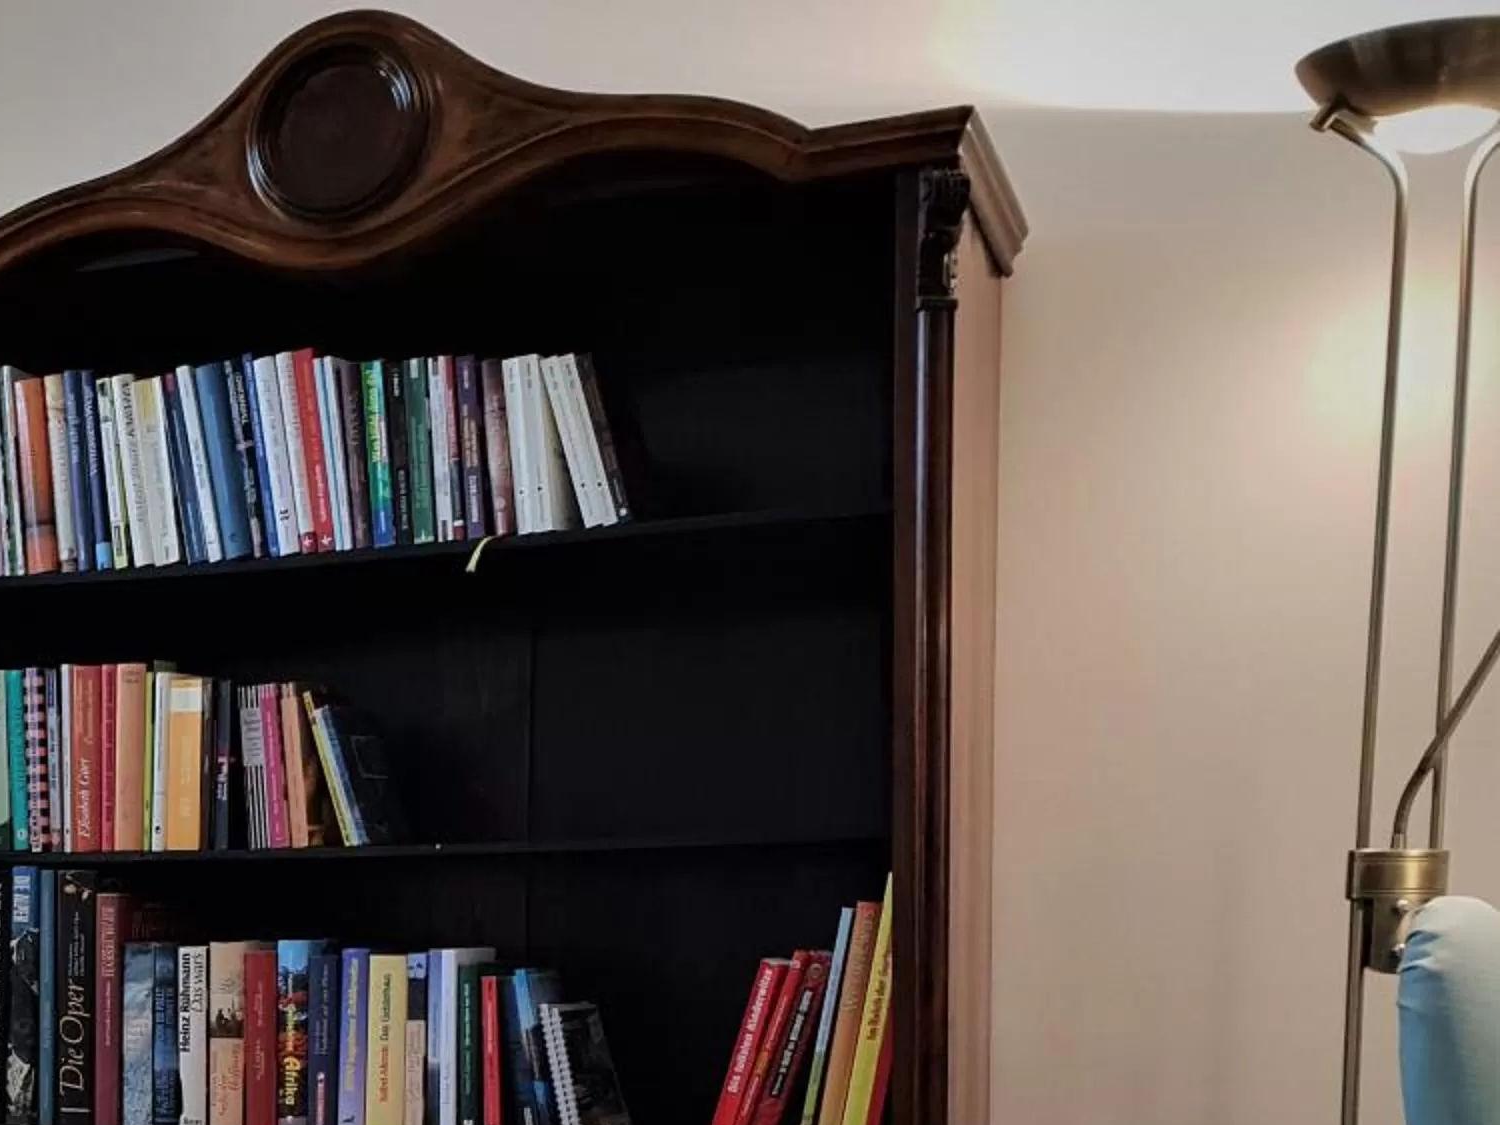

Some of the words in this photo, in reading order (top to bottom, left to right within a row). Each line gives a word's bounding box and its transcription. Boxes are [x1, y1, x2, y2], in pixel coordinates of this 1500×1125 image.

[59, 978, 91, 1045] Oper
[180, 1016, 191, 1052] Heinz
[58, 1047, 85, 1096] Die
